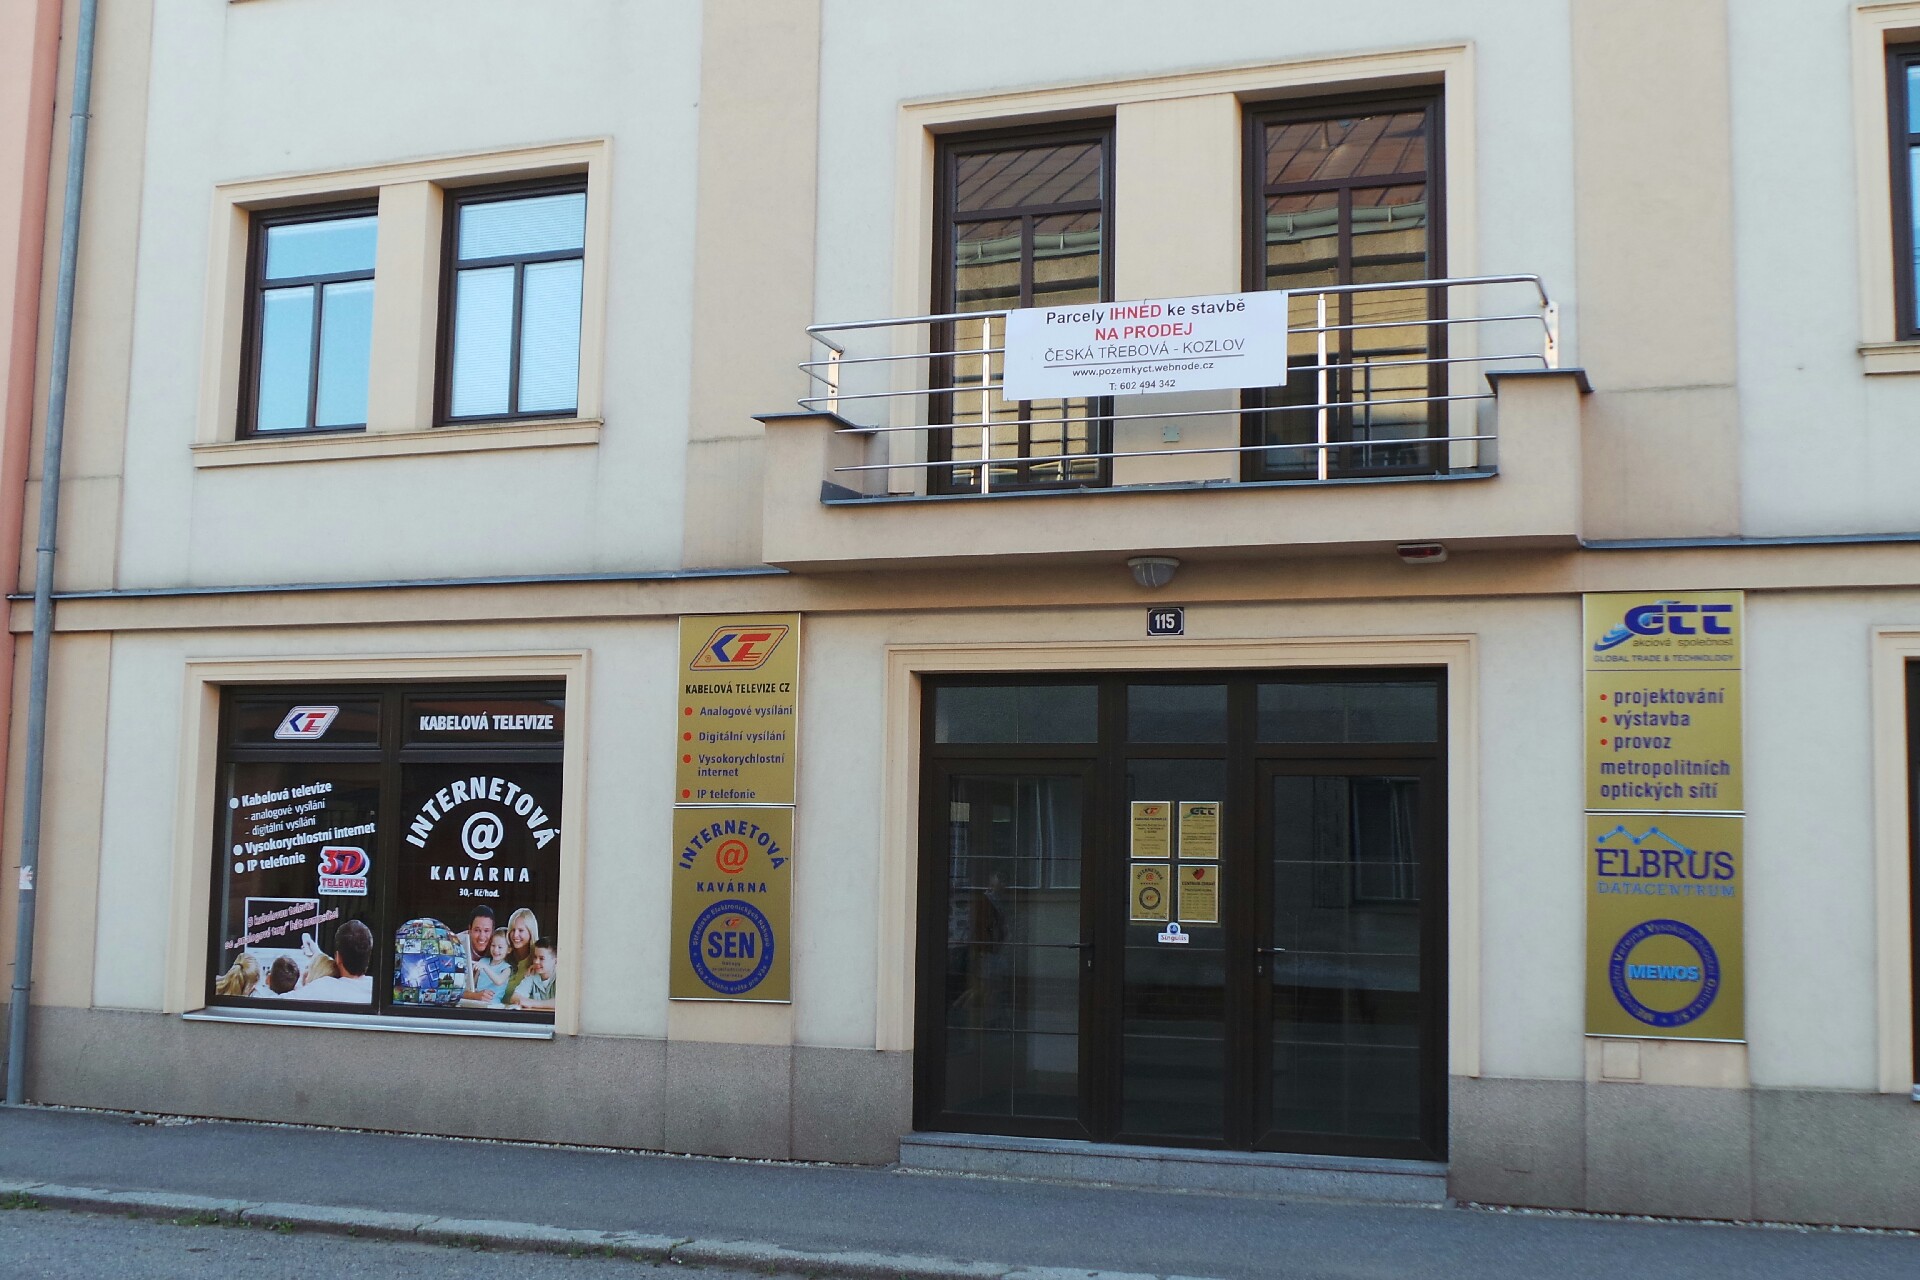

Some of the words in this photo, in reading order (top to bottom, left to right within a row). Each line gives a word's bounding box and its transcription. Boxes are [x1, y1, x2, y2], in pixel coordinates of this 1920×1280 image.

[1046, 309, 1104, 325] Parcely
[1167, 303, 1186, 316] ke
[1191, 299, 1246, 315] stavbě
[1095, 328, 1119, 341] NA
[1124, 322, 1193, 340] PRODEJ
[1044, 345, 1094, 362] ČESKÁ
[1100, 341, 1170, 359] TŘEBOVÁ
[1183, 338, 1245, 354] KOZLOV
[1072, 361, 1214, 377] www.pozemkyct.webnode.cz
[1109, 383, 1117, 391] T:
[1119, 381, 1137, 390] 602
[1139, 380, 1157, 390] 494
[1159, 379, 1176, 389] 342
[1155, 613, 1176, 629] 115
[1632, 638, 1672, 648] akciová
[1677, 637, 1734, 649] společnost
[1593, 654, 1630, 663] GLOBAL
[1632, 654, 1661, 662] TRADE
[1673, 653, 1734, 662] TECHNOLOGY
[685, 681, 733, 694] KABELOVÁ
[735, 683, 776, 694] TELEVIZE
[779, 682, 790, 693] CZ
[1614, 688, 1725, 707] projektování
[420, 711, 489, 730] KABELOVÁ
[492, 714, 553, 730] TELEVIZE
[700, 705, 752, 719] Analogové
[755, 704, 793, 718] vysílání
[1614, 710, 1690, 730] výstavba
[699, 731, 743, 744] Digitální
[746, 730, 786, 743] vysílání
[1614, 736, 1672, 752] provoz
[698, 752, 785, 766] Vysokorychlostní
[698, 767, 739, 777] internet
[1600, 759, 1730, 779] metropolitních
[241, 788, 289, 808] Kabelová
[291, 781, 333, 799] televize
[697, 789, 707, 799] IP
[710, 789, 755, 799] telefonie
[1600, 781, 1683, 801] optických
[1689, 782, 1718, 799] sítí
[250, 805, 293, 822] analogové
[295, 798, 326, 815] vysílání
[405, 776, 560, 850] INTERNETOVÁ
[252, 821, 284, 837] digitální
[286, 815, 316, 831] vysílání
[244, 828, 332, 856] Vysokorychlostní
[334, 822, 376, 840] internet
[461, 811, 504, 861] @
[678, 819, 789, 870] INTERNETOVÁ
[247, 860, 258, 872] IP
[260, 851, 306, 870] telefonie
[321, 850, 365, 875] 3D
[716, 839, 749, 874] @
[1594, 848, 1735, 880] ELBRUS
[430, 863, 530, 882] KAVÁRNA
[321, 878, 365, 888] TELEVIZE
[459, 888, 473, 897] 30,-
[696, 879, 767, 893] KAVÁRNA
[1597, 881, 1736, 897] DATACENTRUM
[708, 931, 755, 958] SEN
[1628, 964, 1700, 982] MEWOS
